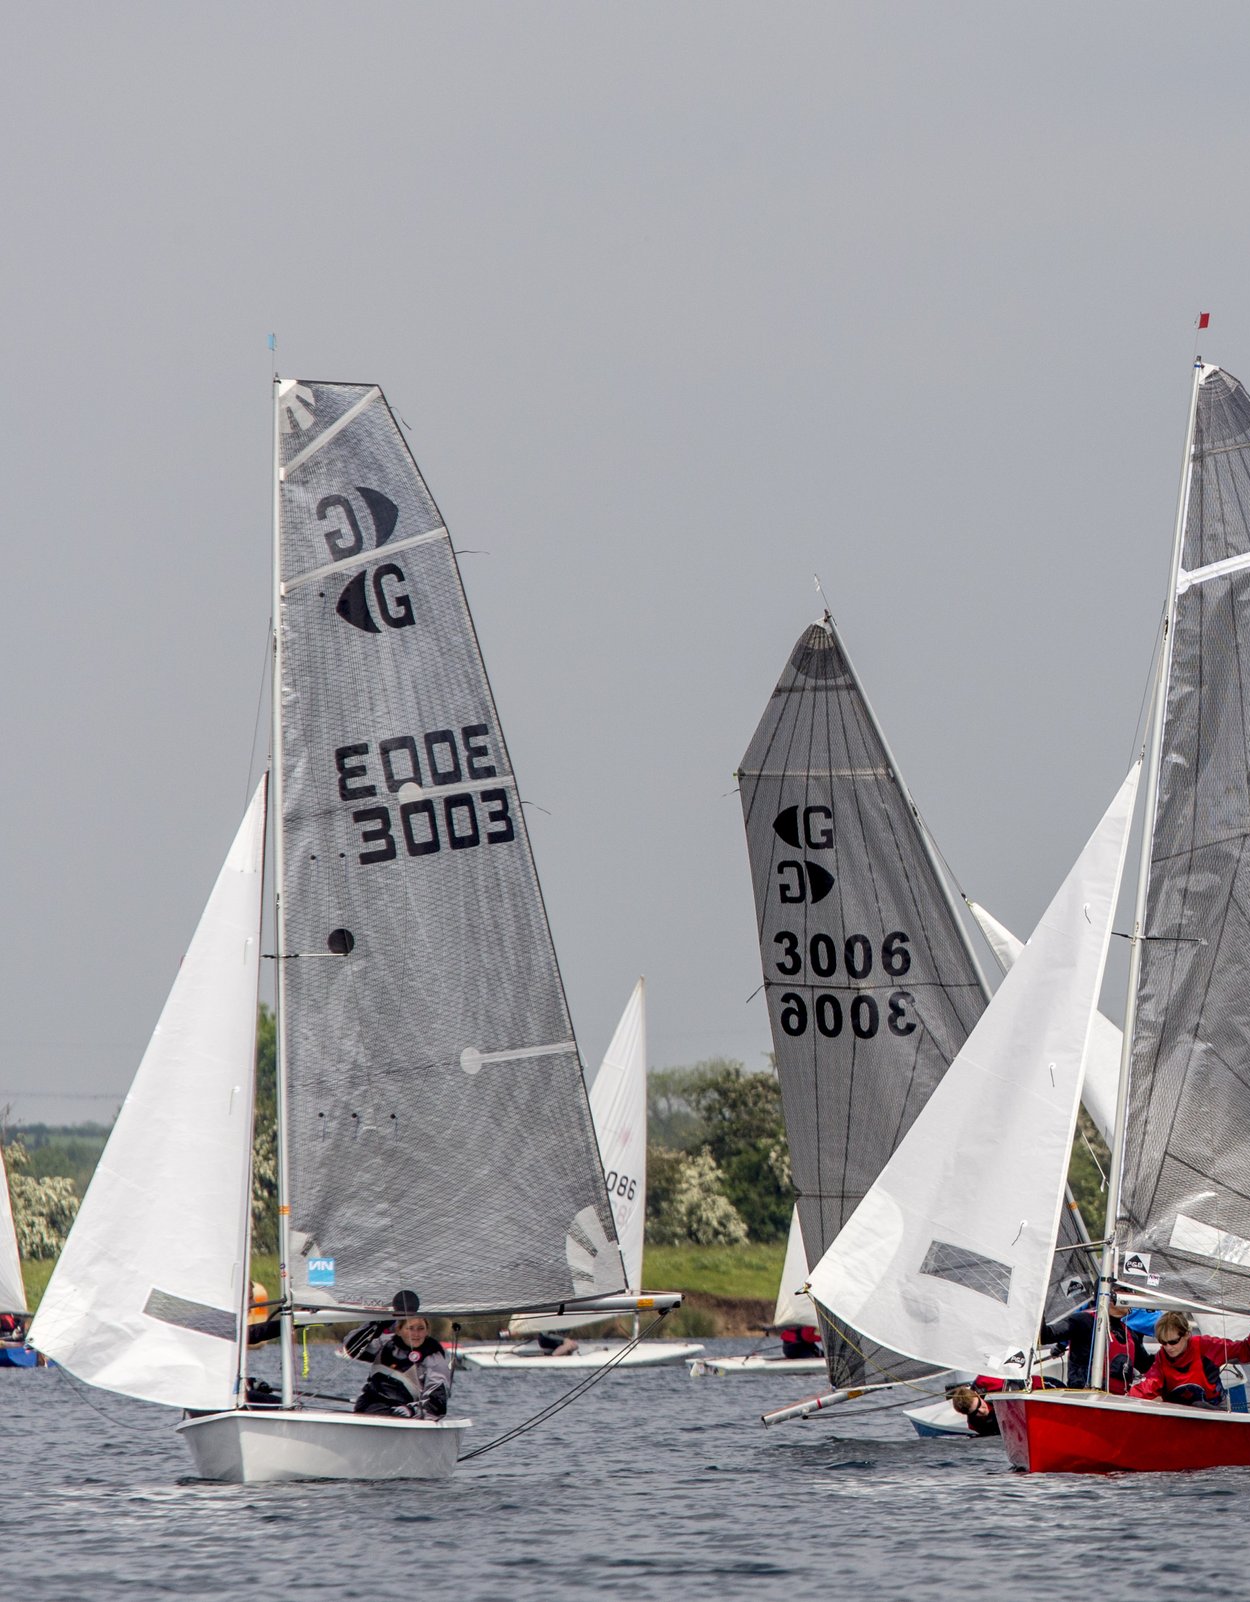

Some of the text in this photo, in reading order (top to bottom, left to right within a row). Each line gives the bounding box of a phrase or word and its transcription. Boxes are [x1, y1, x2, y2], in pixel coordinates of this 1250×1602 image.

[373, 563, 416, 629] G
[353, 788, 515, 866] 3003
[803, 805, 834, 850] G
[773, 931, 911, 979] 3006
